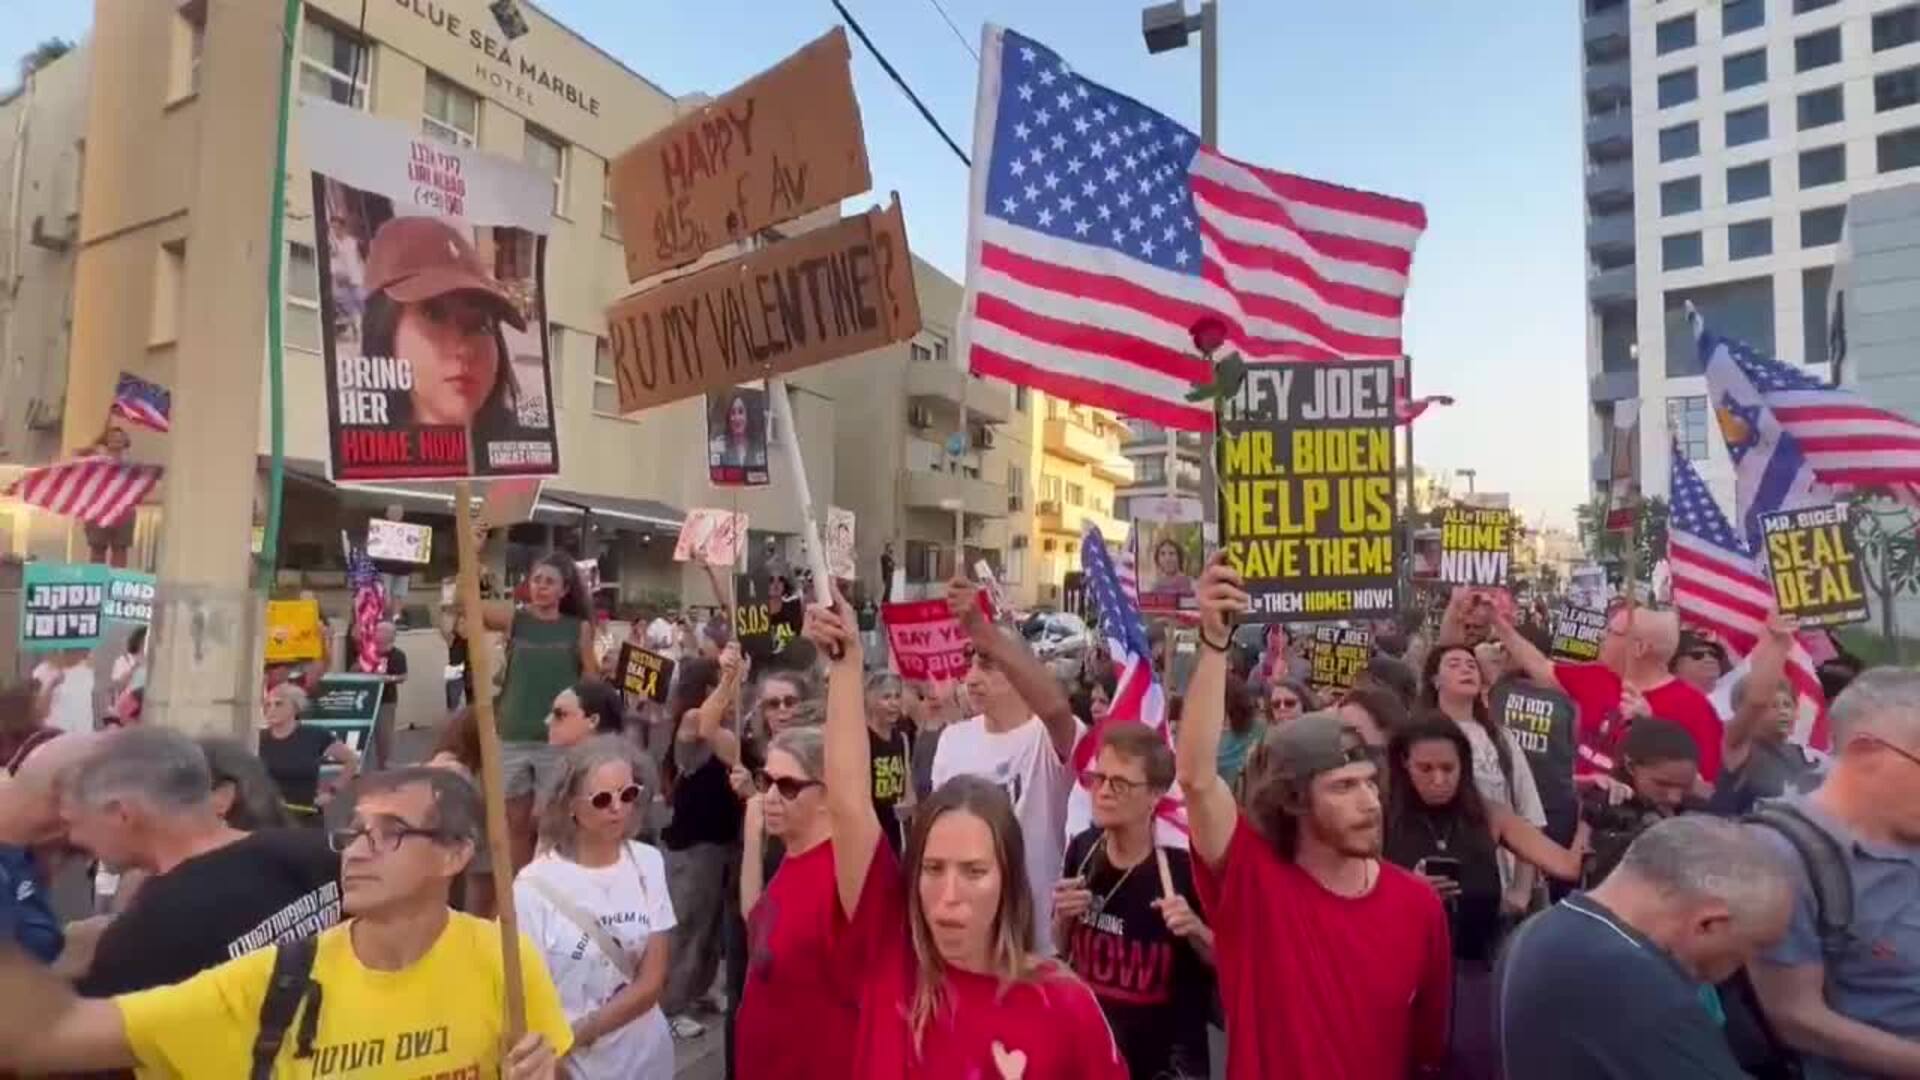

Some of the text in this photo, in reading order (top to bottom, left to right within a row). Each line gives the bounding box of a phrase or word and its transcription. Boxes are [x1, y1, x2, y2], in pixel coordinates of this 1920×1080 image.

[469, 28, 512, 66] SEA
[519, 56, 601, 117] MARBLE
[475, 63, 535, 107] HOTEL
[661, 98, 756, 199] HAPPY
[660, 299, 704, 385] MY
[337, 356, 412, 390] BRING
[1301, 367, 1389, 419] JOE!
[340, 391, 389, 424] HER
[342, 431, 410, 464] HOME
[1224, 428, 1390, 476] MR. BIDEN
[1227, 477, 1391, 536] HELP US
[1229, 537, 1393, 578] SAVE THEM!
[1443, 524, 1509, 551] HOME
[1768, 525, 1854, 573] SEAL
[1441, 551, 1508, 585] NOW!
[1777, 567, 1863, 611] DEAL
[1263, 593, 1303, 613] THEM
[1305, 590, 1352, 613] HOME!
[1354, 588, 1393, 609] NOW!
[395, 1025, 448, 1061] בשם
